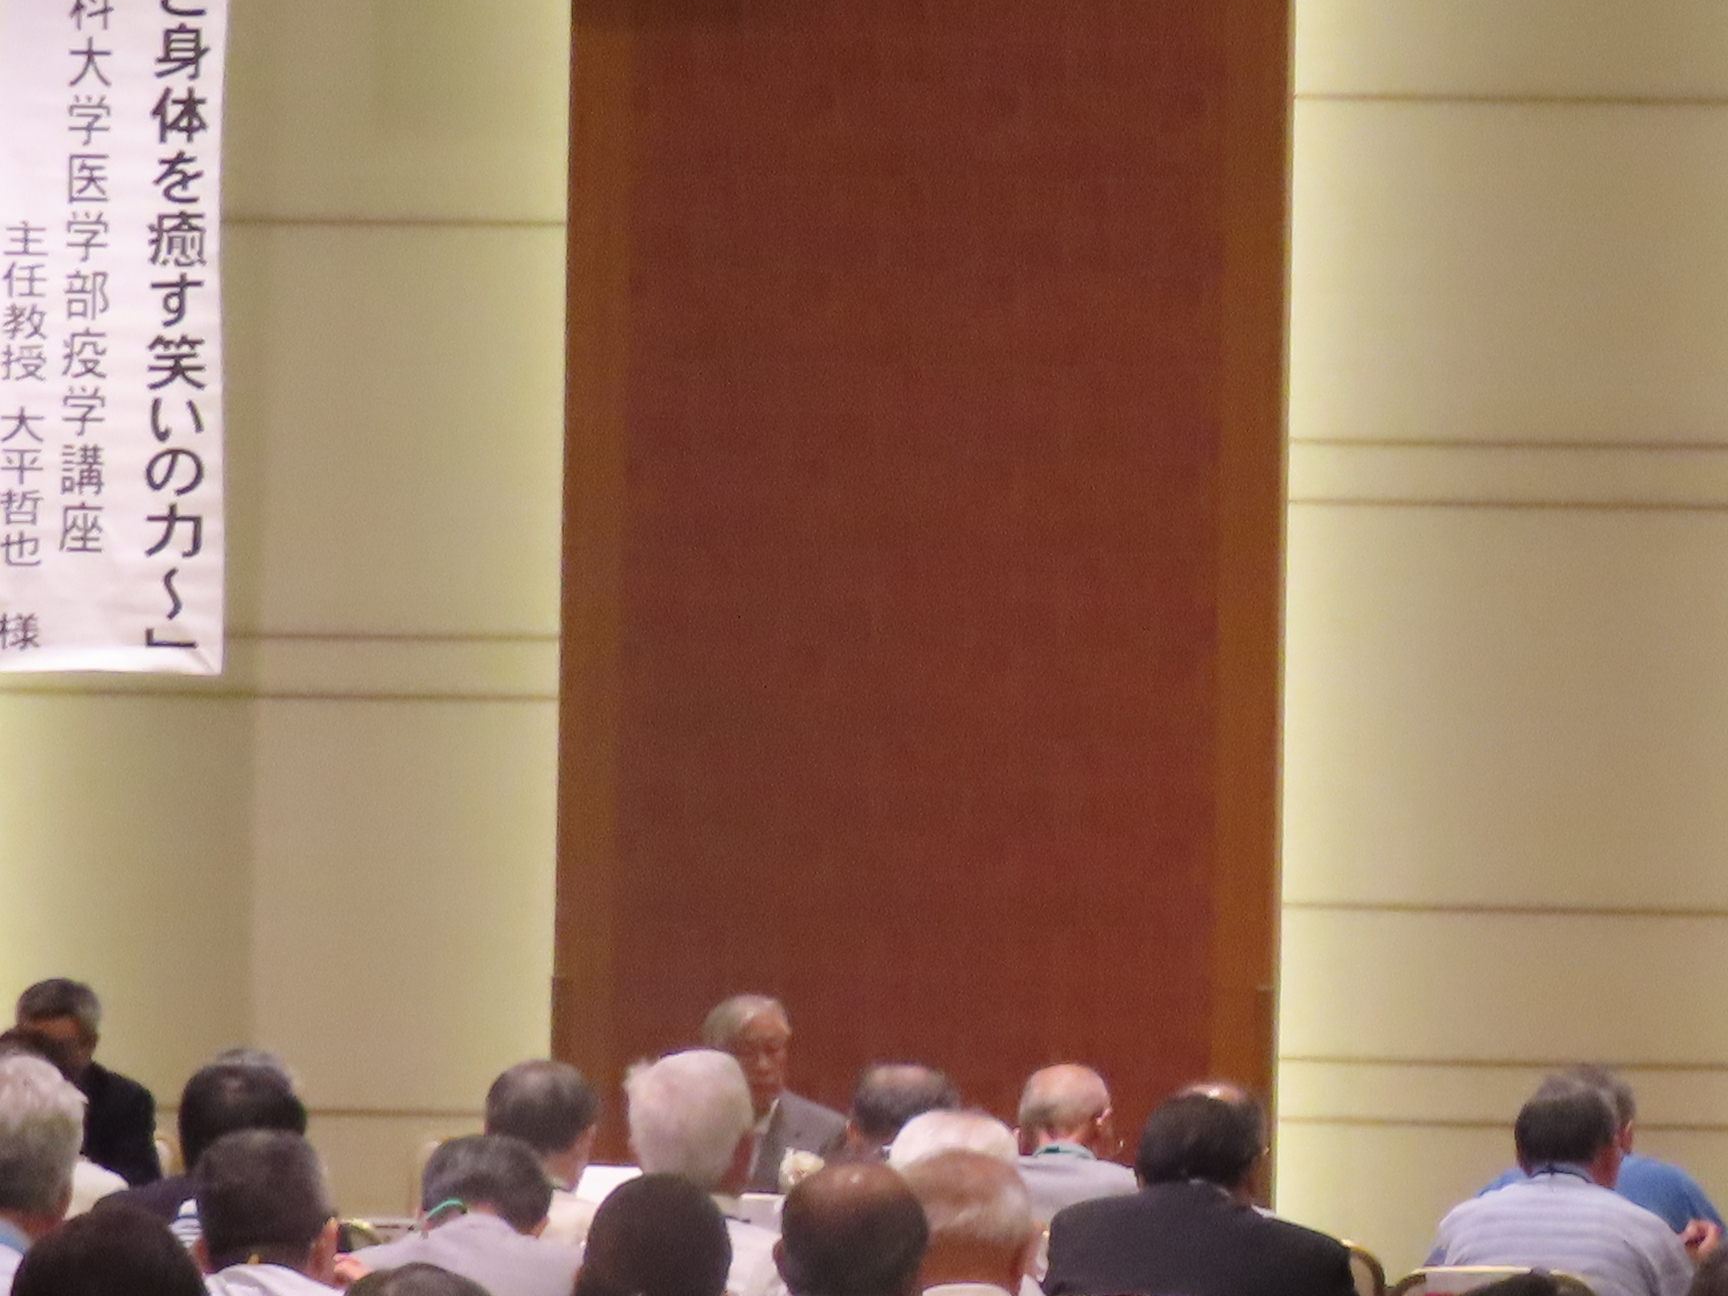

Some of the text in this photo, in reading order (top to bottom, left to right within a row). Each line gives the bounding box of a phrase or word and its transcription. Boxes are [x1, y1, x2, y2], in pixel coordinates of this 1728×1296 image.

[1, 220, 48, 382] 主任教授
[0, 406, 45, 568] 大平哲也
